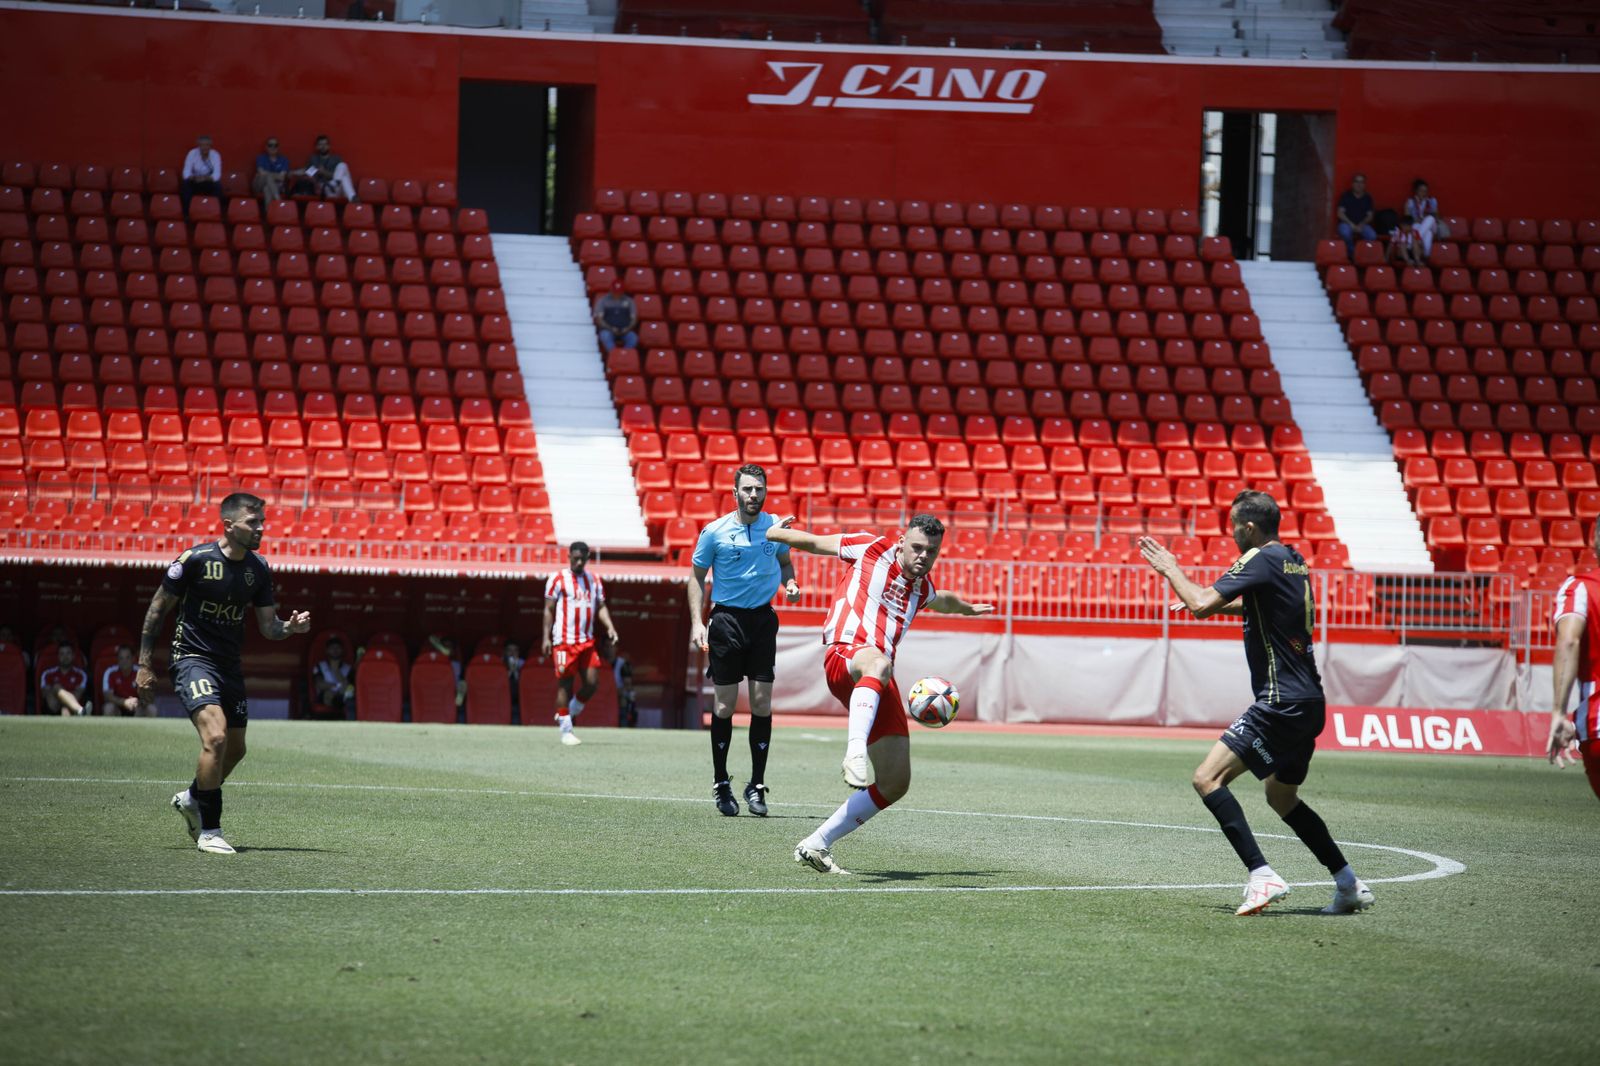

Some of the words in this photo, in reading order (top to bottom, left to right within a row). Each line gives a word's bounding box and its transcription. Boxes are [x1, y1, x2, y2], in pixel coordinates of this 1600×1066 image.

[203, 560, 224, 580] 10
[189, 678, 213, 700] 10
[1333, 712, 1483, 751] LALIGA
